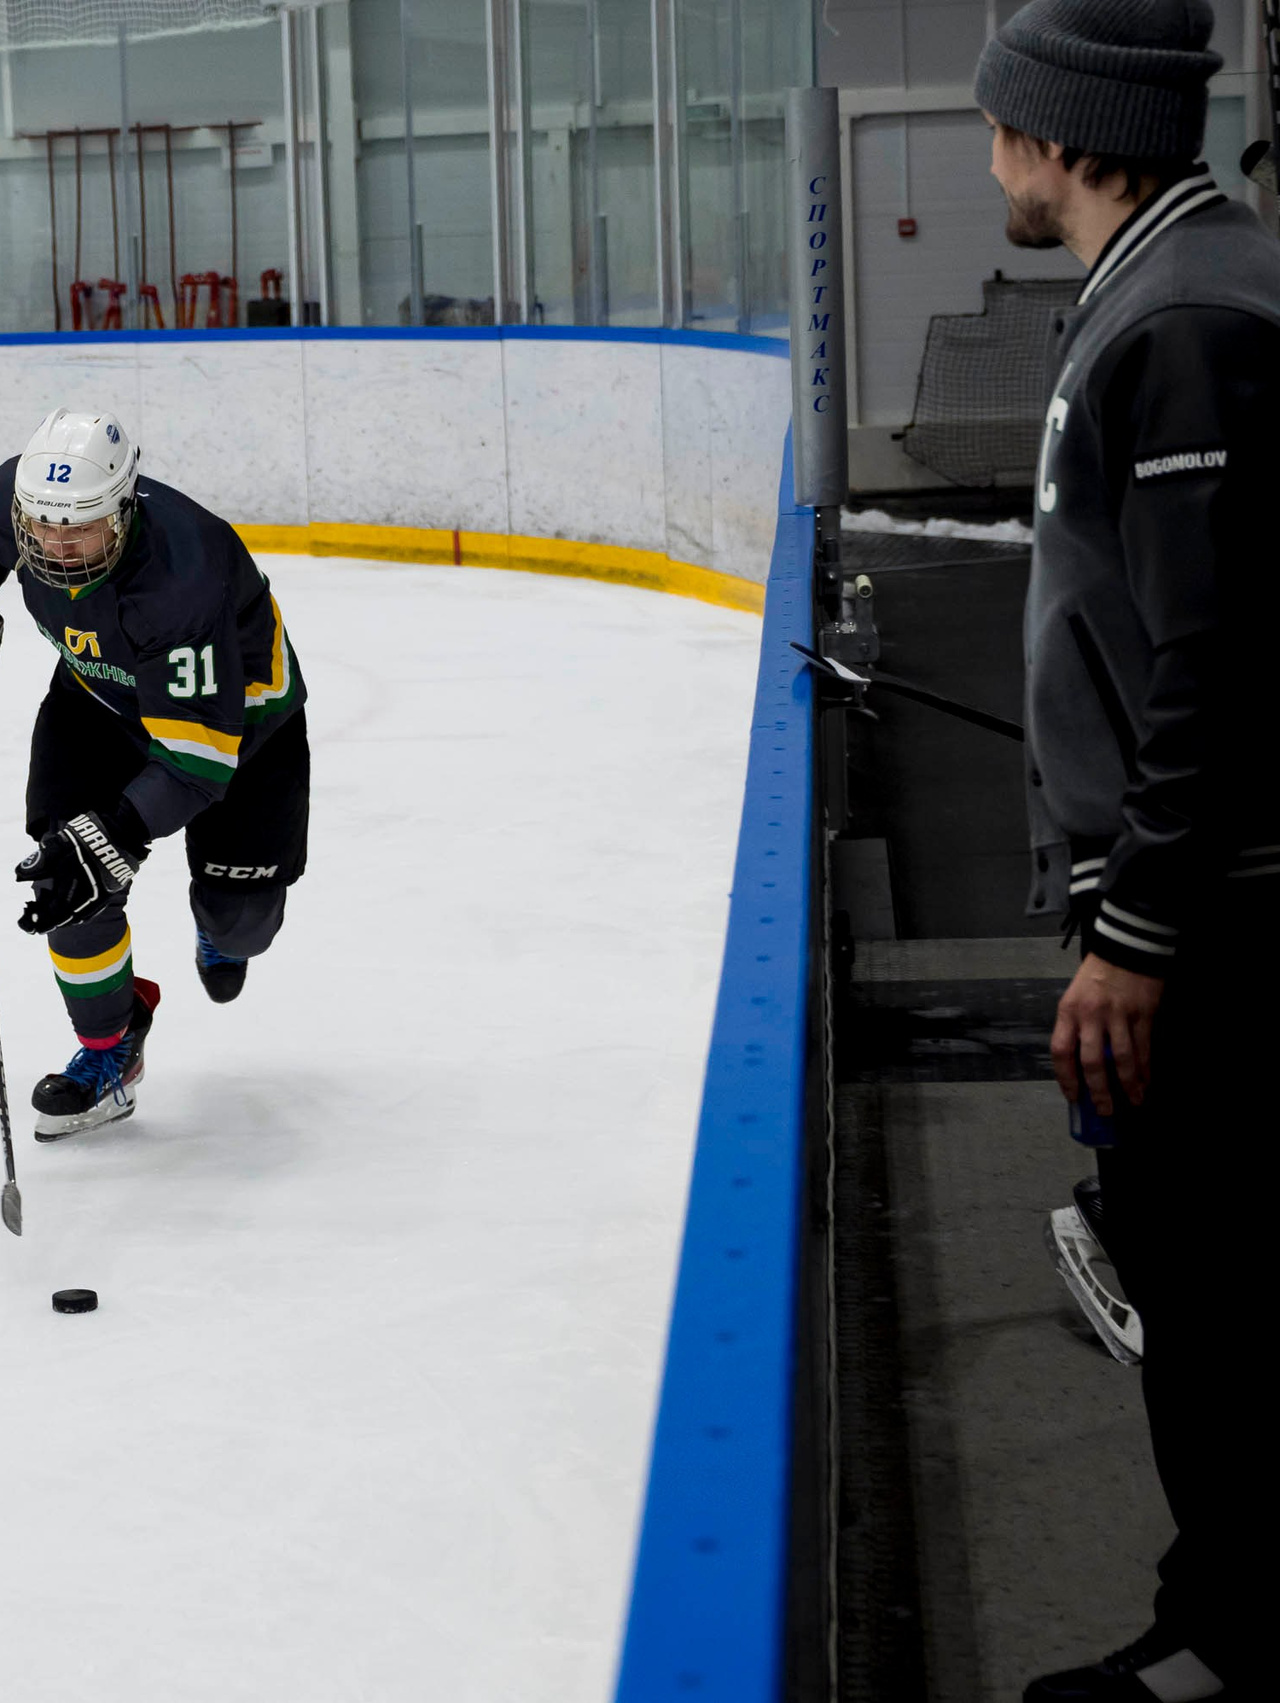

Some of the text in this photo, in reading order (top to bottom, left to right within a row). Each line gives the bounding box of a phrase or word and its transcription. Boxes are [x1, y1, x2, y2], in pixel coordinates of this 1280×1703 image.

[807, 176, 831, 413] СПОРТМАКС
[46, 463, 72, 483] 12
[1134, 450, 1227, 479] BOGOMOLOV
[36, 499, 72, 509] BAUER
[168, 644, 218, 698] 31
[204, 862, 279, 879] CCM
